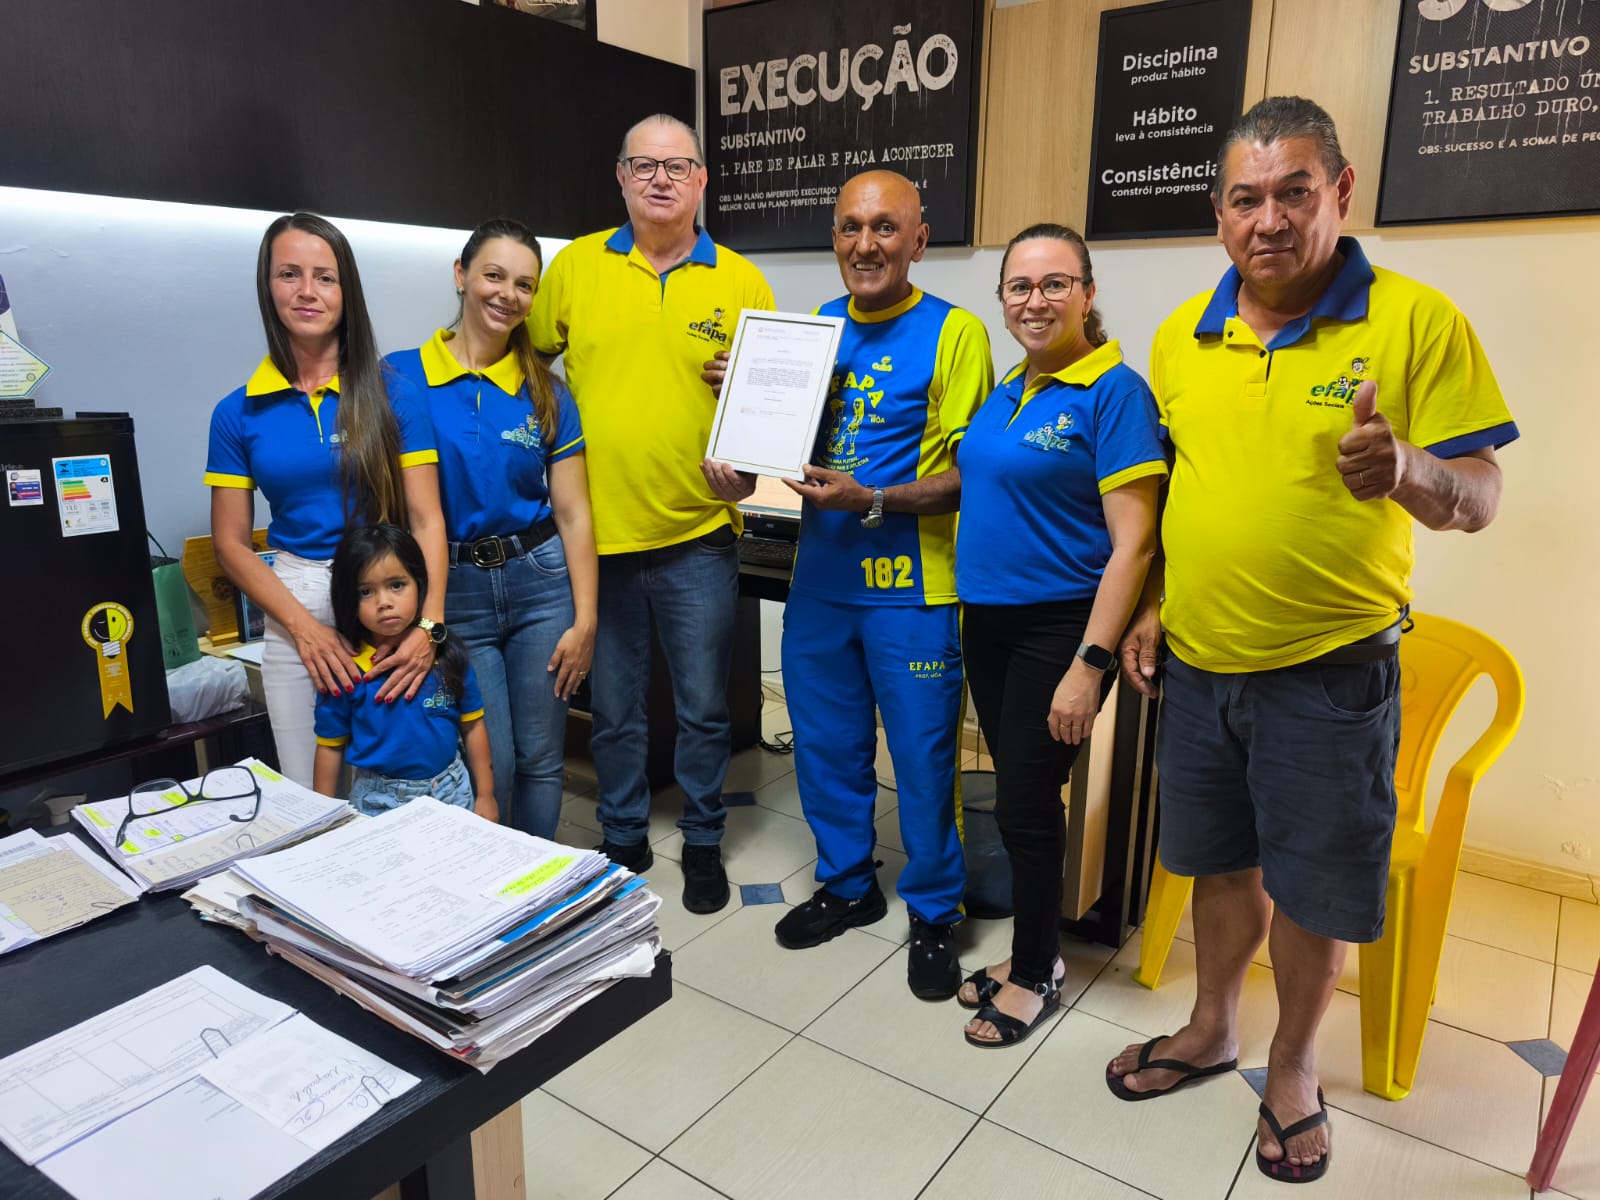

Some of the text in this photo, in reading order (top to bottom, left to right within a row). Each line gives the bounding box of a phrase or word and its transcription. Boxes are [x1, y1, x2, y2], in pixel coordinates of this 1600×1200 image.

[1122, 45, 1218, 72] Disciplina
[1408, 35, 1590, 74] SUBSTANTIVO
[719, 23, 959, 117] EXECUÇÃO
[1131, 66, 1207, 86] produz hábito
[1423, 89, 1440, 105] 1.
[1450, 76, 1569, 102] RESULTADO
[1133, 105, 1198, 127] Hábito
[1422, 96, 1599, 126] TRABALHO DURO,
[720, 127, 807, 151] SUBSTANTIVO
[1115, 124, 1214, 142] leva à consistência
[1418, 144, 1443, 155] OBS:
[1444, 140, 1494, 153] SUCESSO
[1509, 138, 1518, 148] A
[1522, 135, 1558, 147] SOMA
[1562, 133, 1578, 144] DE
[720, 143, 954, 177] 1. PARE DE FALAR E FAÇA ACONTECER
[1101, 160, 1217, 185] Consistência
[719, 194, 732, 203] OBS:
[733, 193, 743, 202] UM
[744, 191, 765, 200] PLANO
[766, 187, 800, 199] IMPERFEITO
[801, 185, 838, 197] EXECUTADO
[1111, 182, 1208, 197] constrói progresso
[719, 202, 742, 212] MELHOR
[743, 201, 756, 210] QUE
[757, 201, 768, 209] UM
[768, 199, 789, 209] PLANO
[790, 197, 818, 207] PERFEITO
[861, 555, 914, 589] 182
[909, 660, 946, 671] EFAPA
